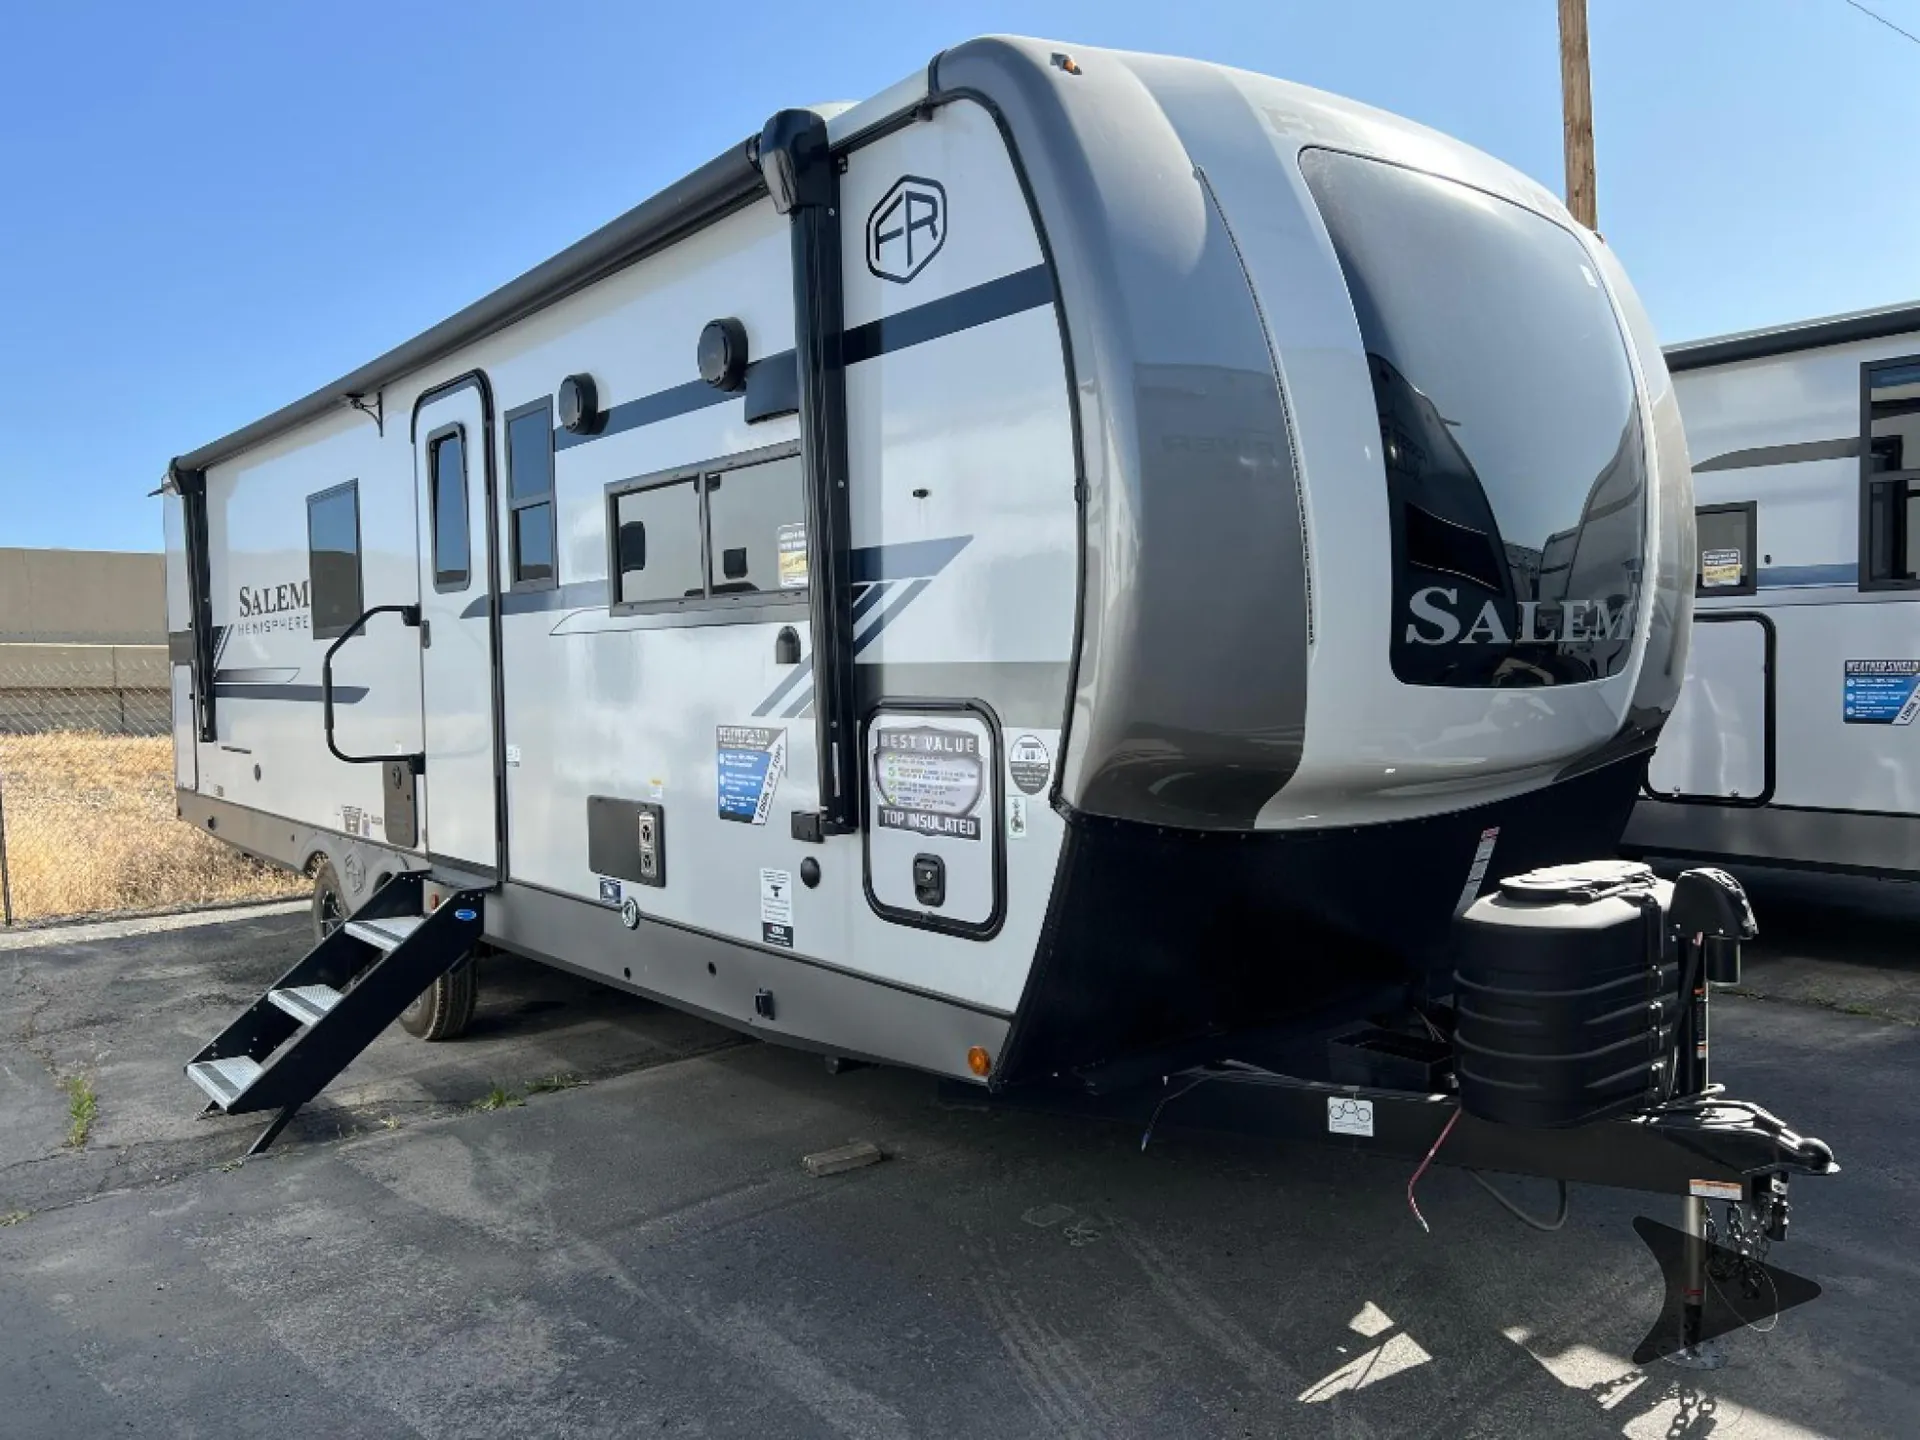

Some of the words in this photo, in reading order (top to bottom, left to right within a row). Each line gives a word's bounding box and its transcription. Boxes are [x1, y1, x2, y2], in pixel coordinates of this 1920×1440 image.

[875, 189, 938, 268] FR
[239, 580, 310, 618] SALEM
[1406, 586, 1635, 646] SALEM
[881, 733, 917, 750] BEST
[925, 735, 975, 753] VALUE
[883, 809, 905, 826] TOP
[907, 812, 976, 836] INSULATED
